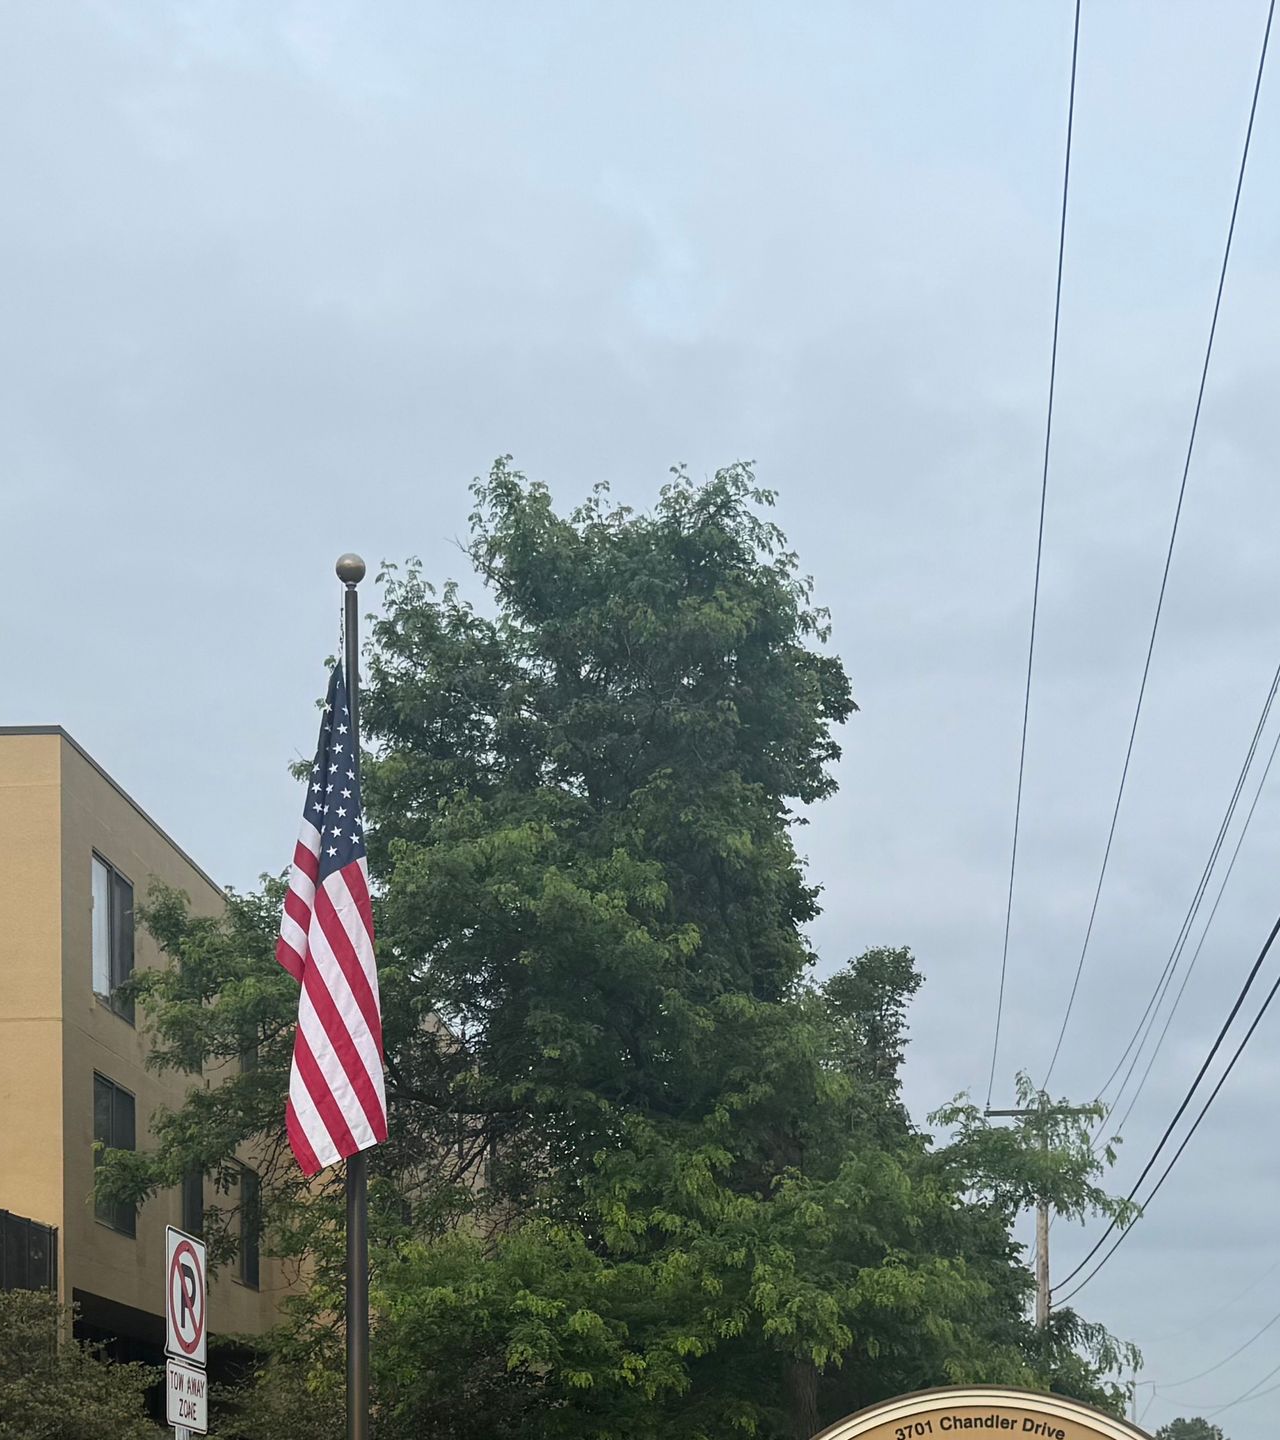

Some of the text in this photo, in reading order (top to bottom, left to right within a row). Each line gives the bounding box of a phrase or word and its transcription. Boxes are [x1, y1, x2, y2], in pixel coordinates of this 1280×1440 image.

[170, 1370, 205, 1398] TOW AWAY
[179, 1398, 196, 1421] ZONE
[939, 1414, 1018, 1431] Chandler
[1022, 1417, 1066, 1440] Drive
